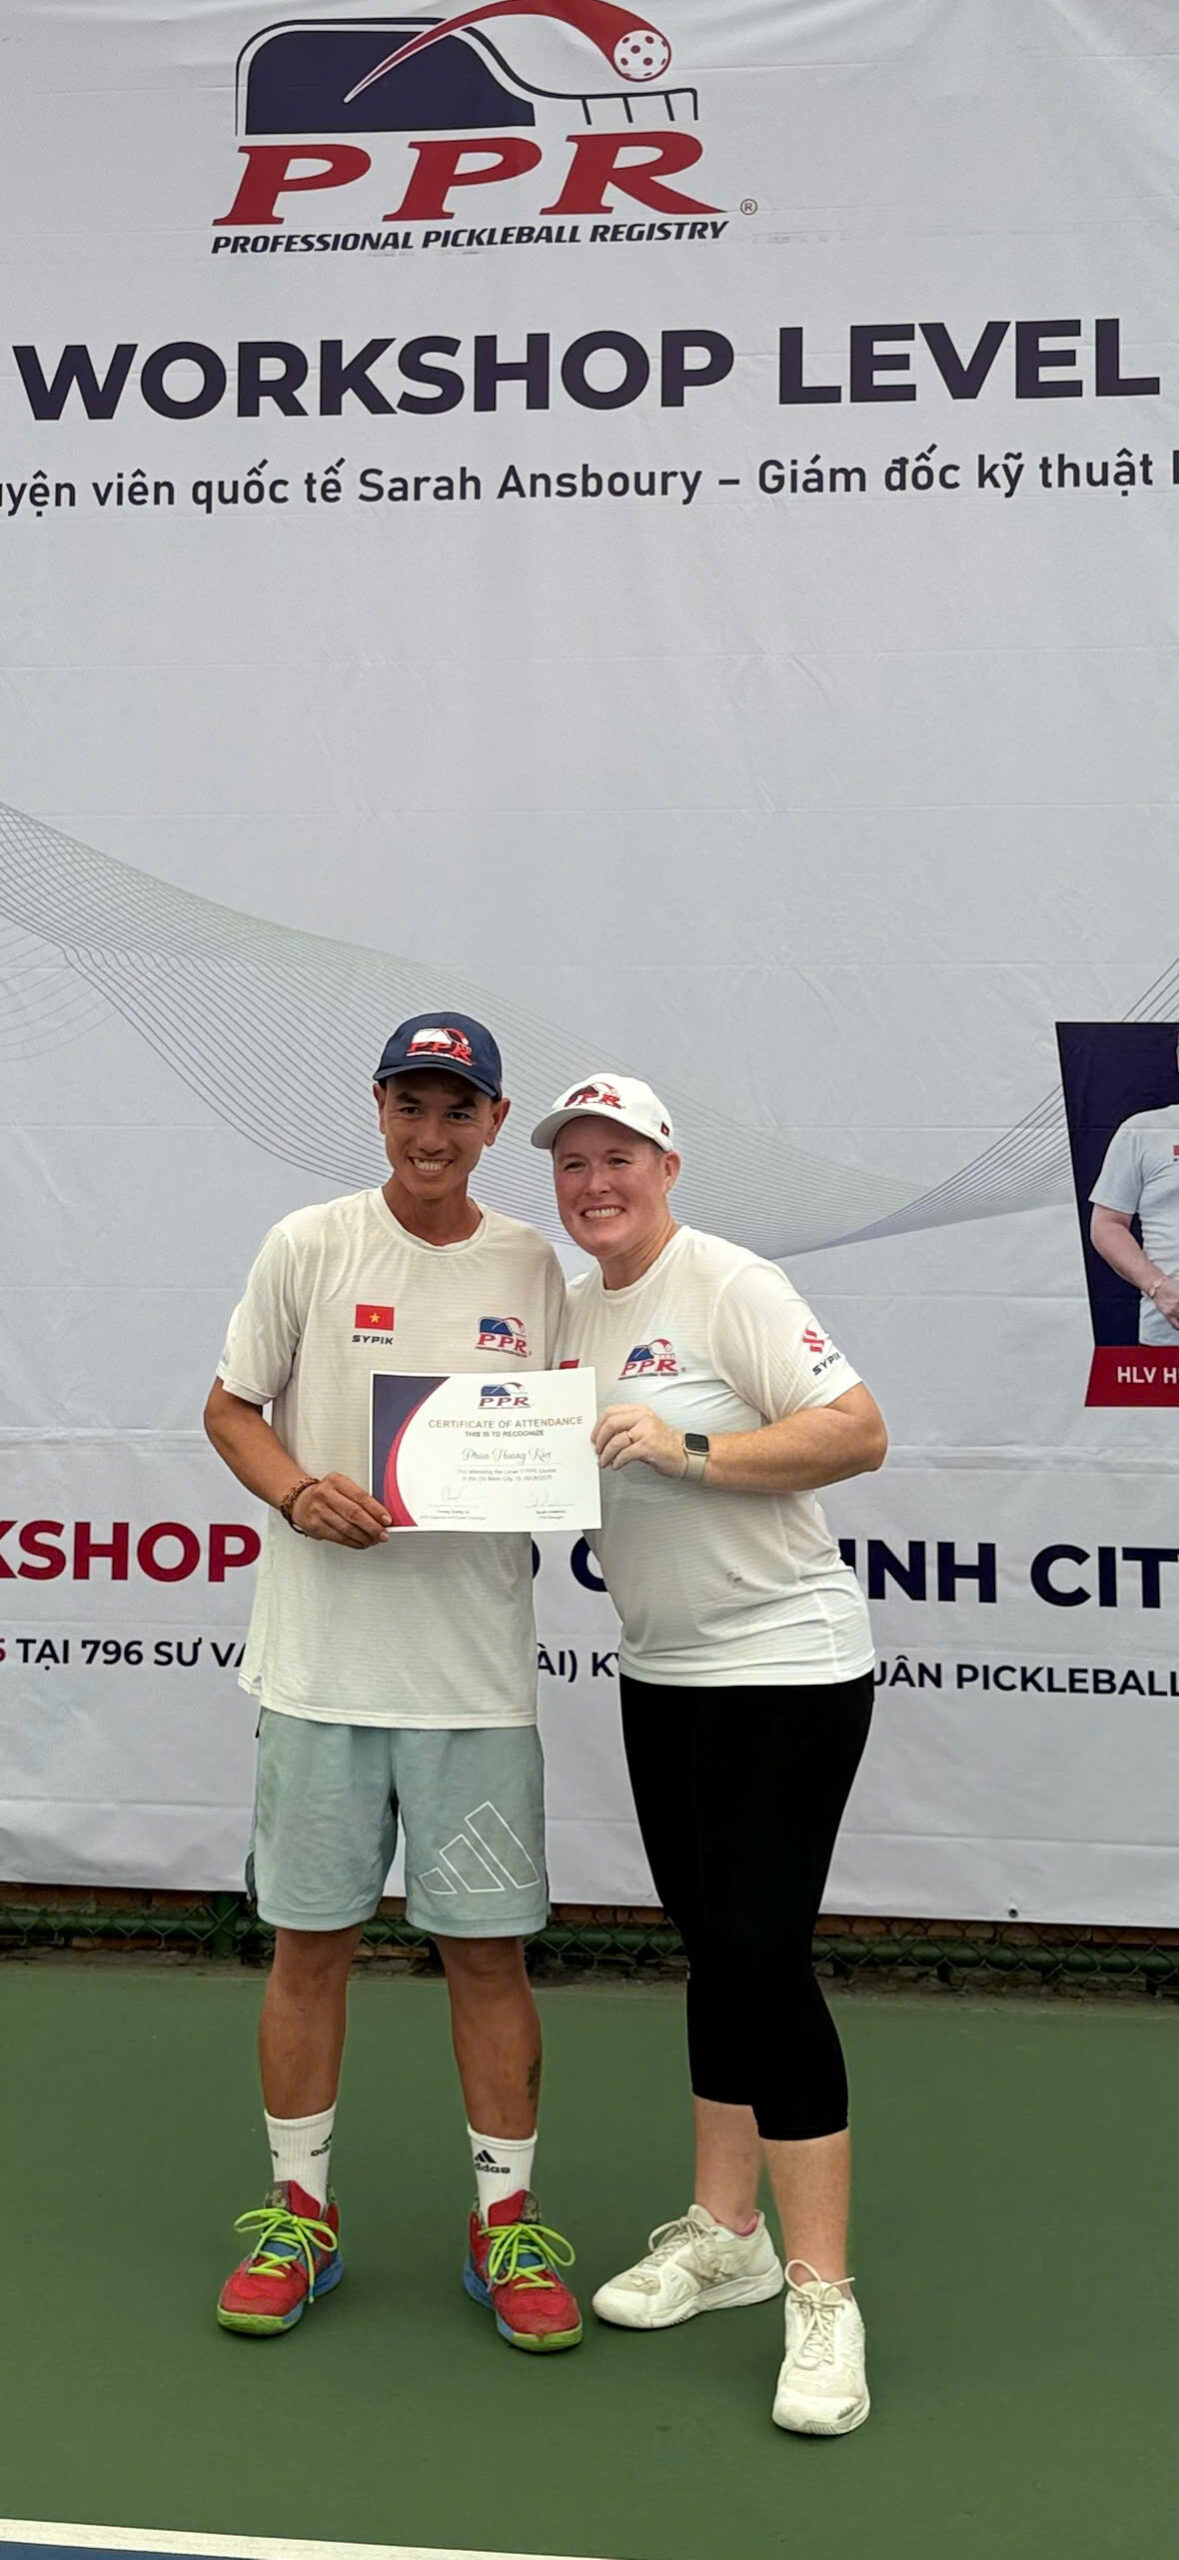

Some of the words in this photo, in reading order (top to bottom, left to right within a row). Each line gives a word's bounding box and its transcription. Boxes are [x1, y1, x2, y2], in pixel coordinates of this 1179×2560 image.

[212, 131, 728, 227] PPR
[212, 232, 413, 253] PROFESSIONAL
[422, 226, 580, 248] PICKLEBALL
[590, 221, 728, 242] REGISTRY
[12, 330, 734, 420] WORKSHOP
[779, 319, 1160, 404] LEVEL
[0, 469, 76, 517] yện
[92, 469, 174, 506] viên
[193, 459, 288, 514] quốc
[305, 458, 345, 503] tế
[359, 467, 480, 502] Sarah
[497, 464, 702, 505] Ansboury
[759, 454, 865, 494] Giám
[885, 444, 960, 491] đốc
[979, 453, 1024, 498] kỹ
[1040, 448, 1152, 496] thuật
[408, 1042, 473, 1064] PPR
[352, 1335, 394, 1345] SYPIK
[478, 1334, 528, 1354] PPR
[621, 1359, 679, 1376] PPR
[1117, 1366, 1157, 1384] HLV
[478, 1397, 530, 1407] PPR
[428, 1419, 495, 1429] CERTIFICATE
[498, 1419, 512, 1428] OF
[515, 1416, 583, 1428] ATTENDANCE
[16, 1639, 69, 1670] TẠI
[82, 1640, 143, 1665] 796
[154, 1638, 202, 1666] SƯ
